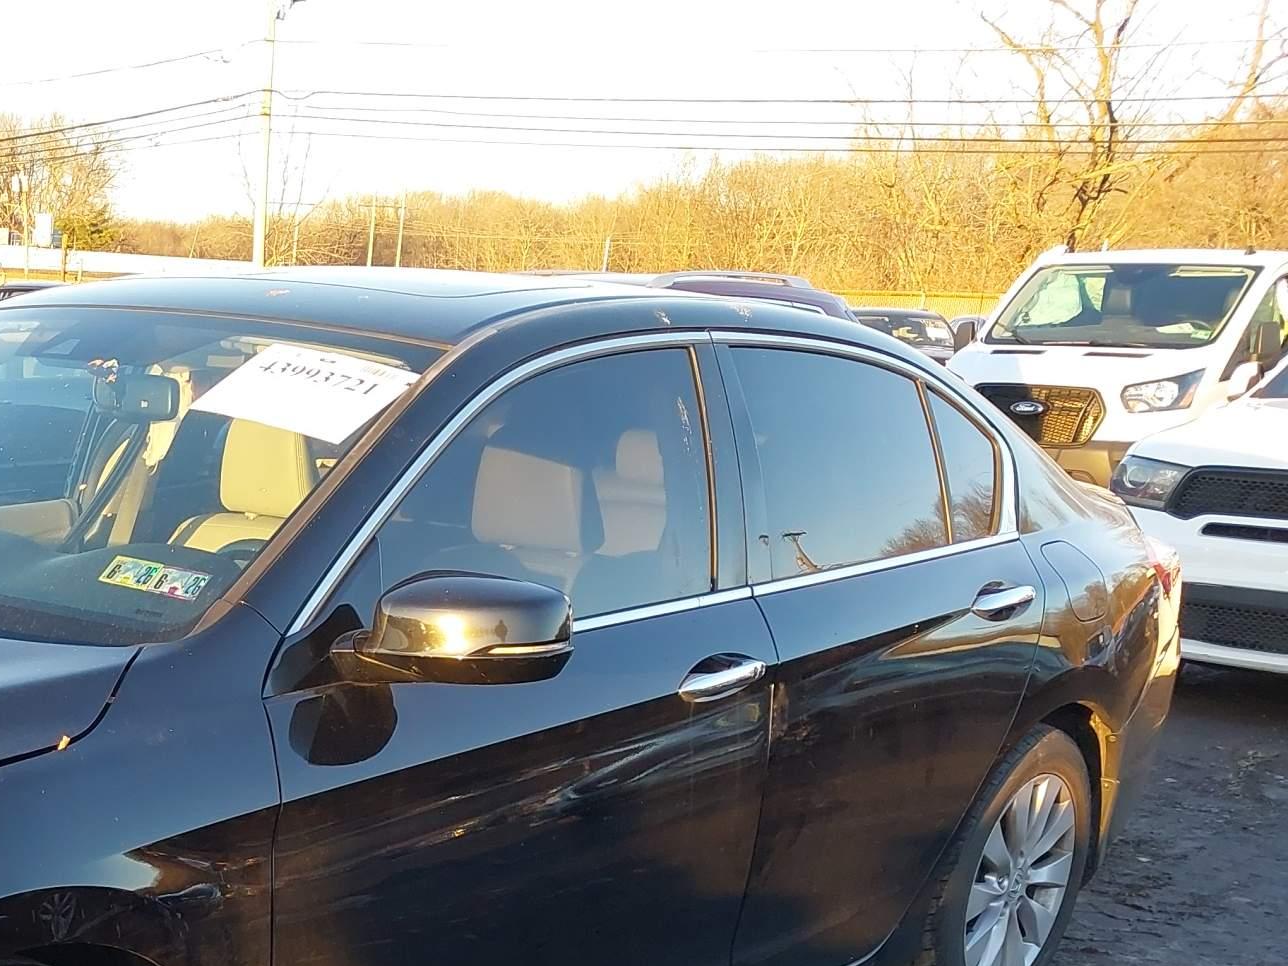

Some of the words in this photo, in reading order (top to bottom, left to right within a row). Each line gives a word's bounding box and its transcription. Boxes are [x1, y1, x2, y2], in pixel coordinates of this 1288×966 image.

[259, 359, 379, 396] 43993721
[105, 563, 122, 580] 6
[135, 565, 158, 585] 26
[153, 572, 169, 590] 6
[184, 575, 207, 596] 26
